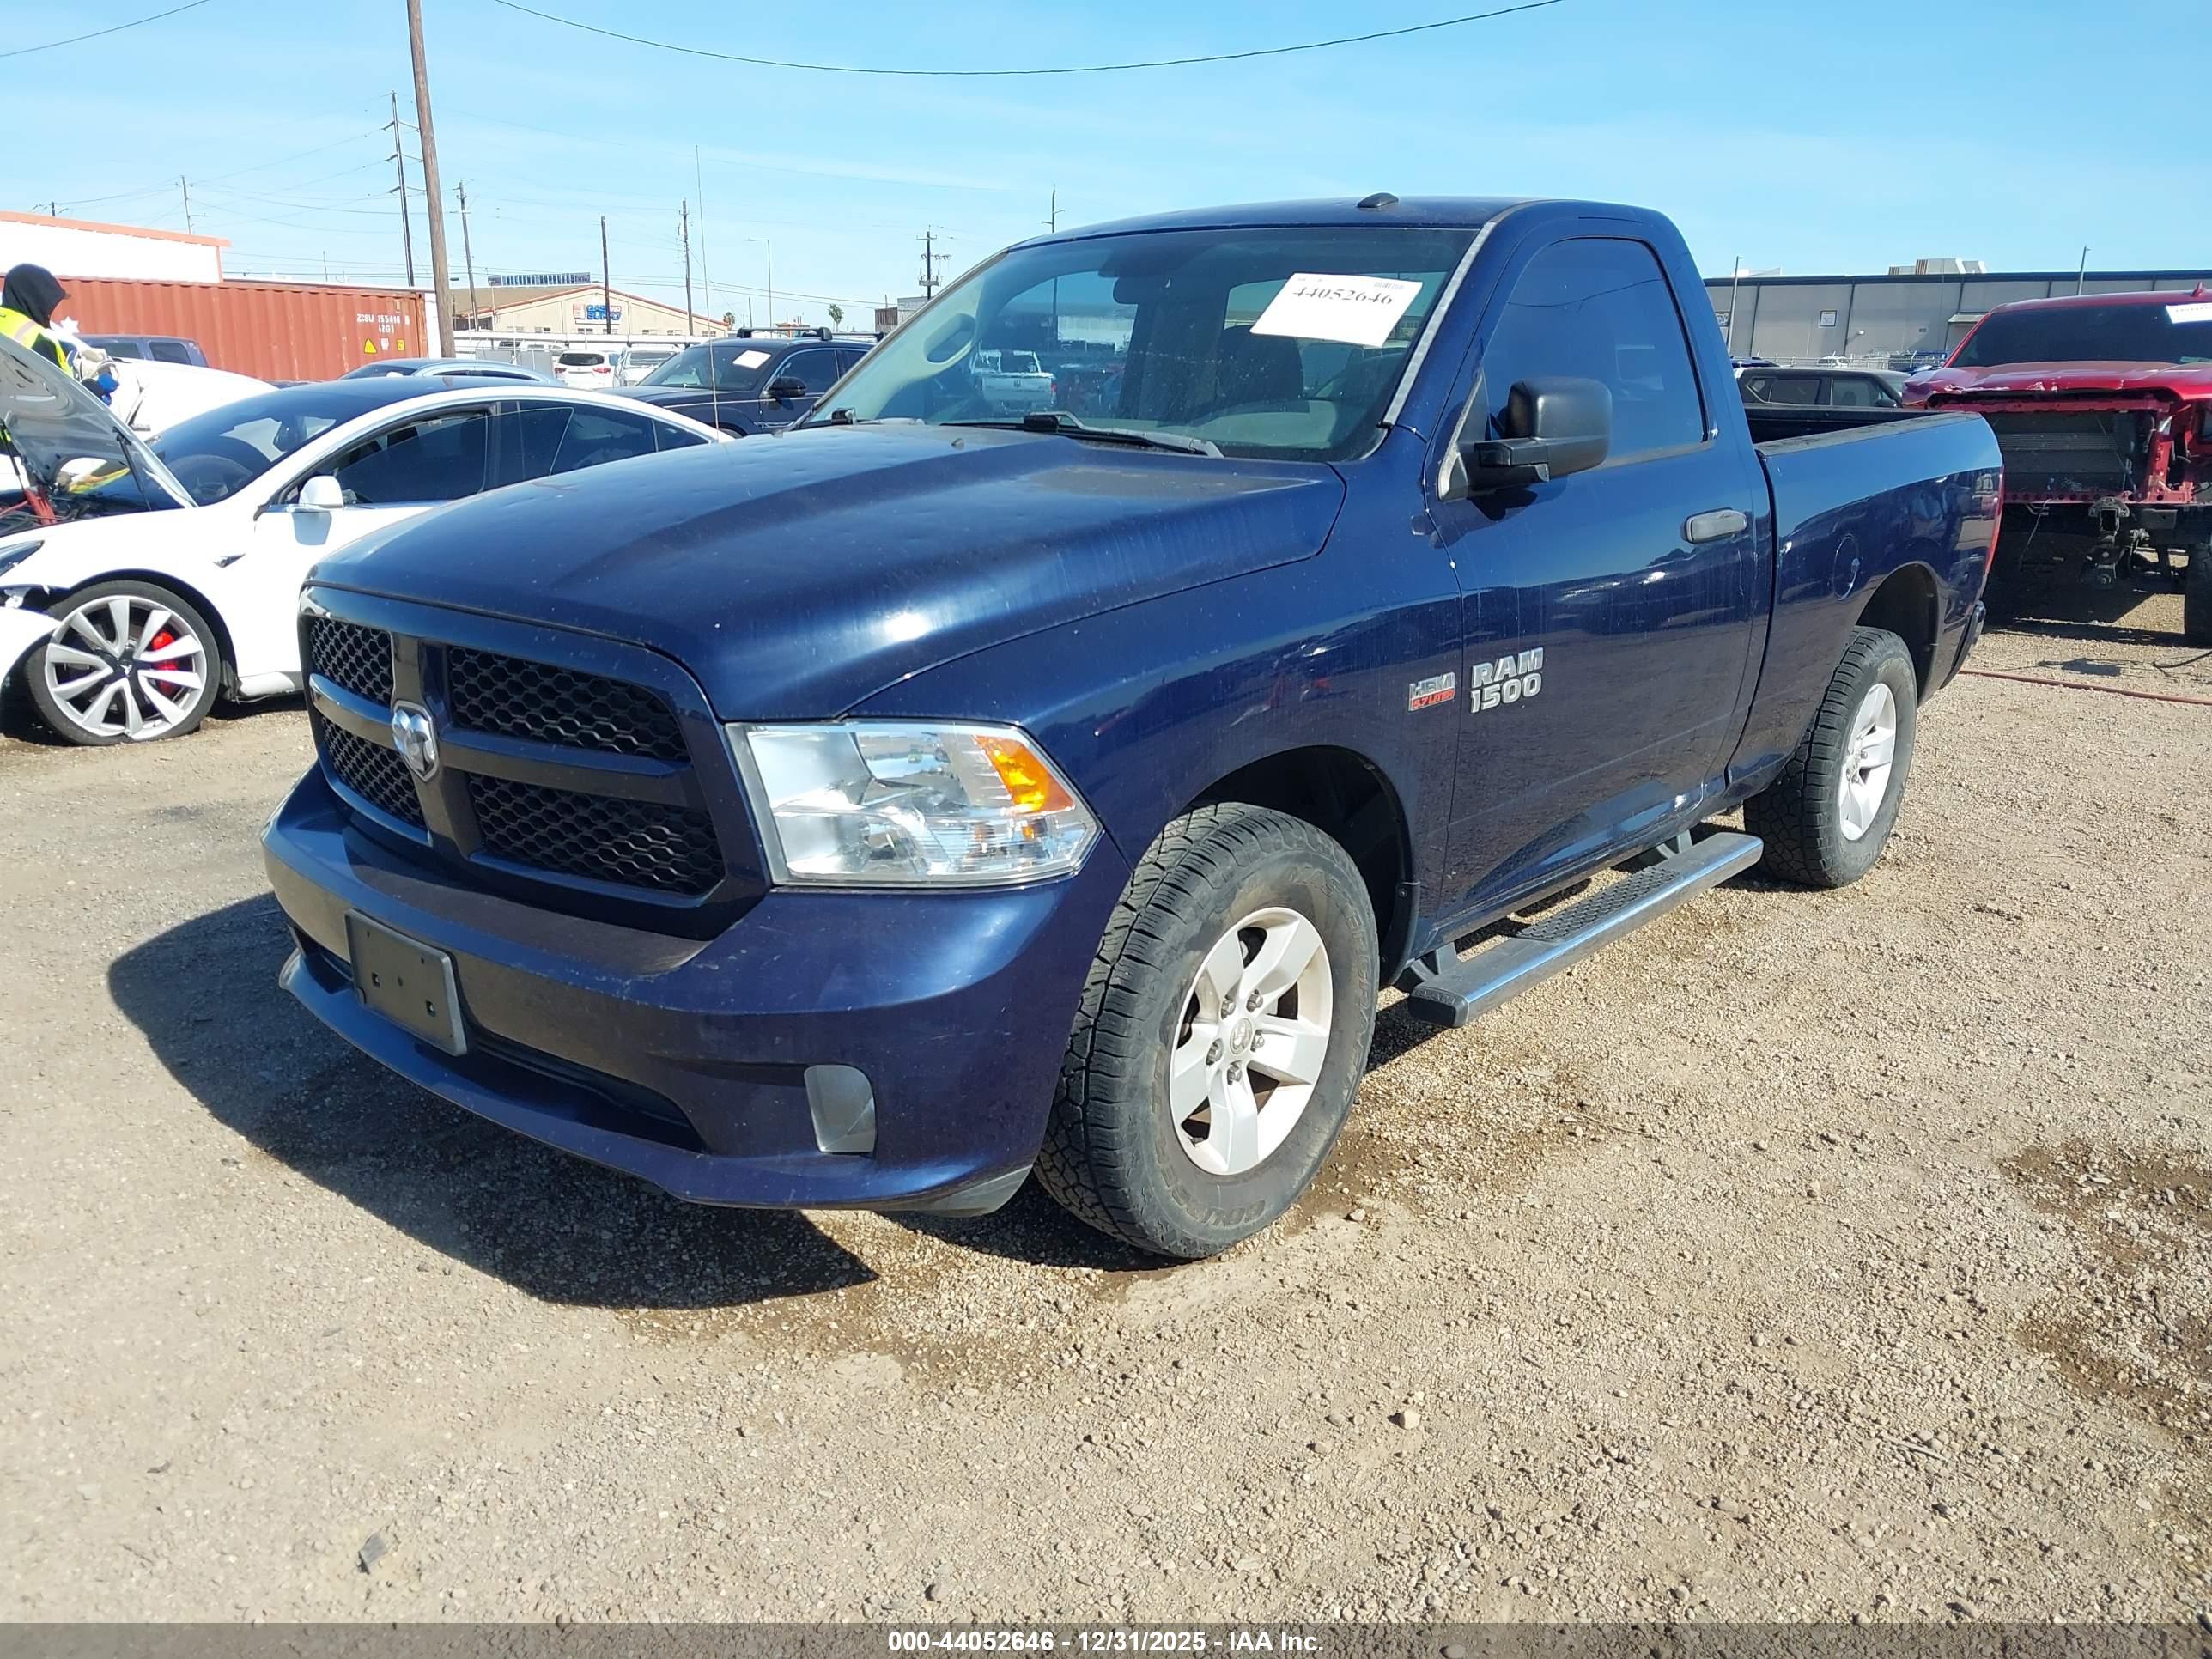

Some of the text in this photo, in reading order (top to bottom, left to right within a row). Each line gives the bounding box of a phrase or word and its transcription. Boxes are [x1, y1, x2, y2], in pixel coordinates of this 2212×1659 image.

[1293, 287, 1393, 305] 44052646
[1472, 647, 1543, 688] RAM
[1410, 672, 1455, 698] HEMI
[1471, 673, 1542, 714] 1500
